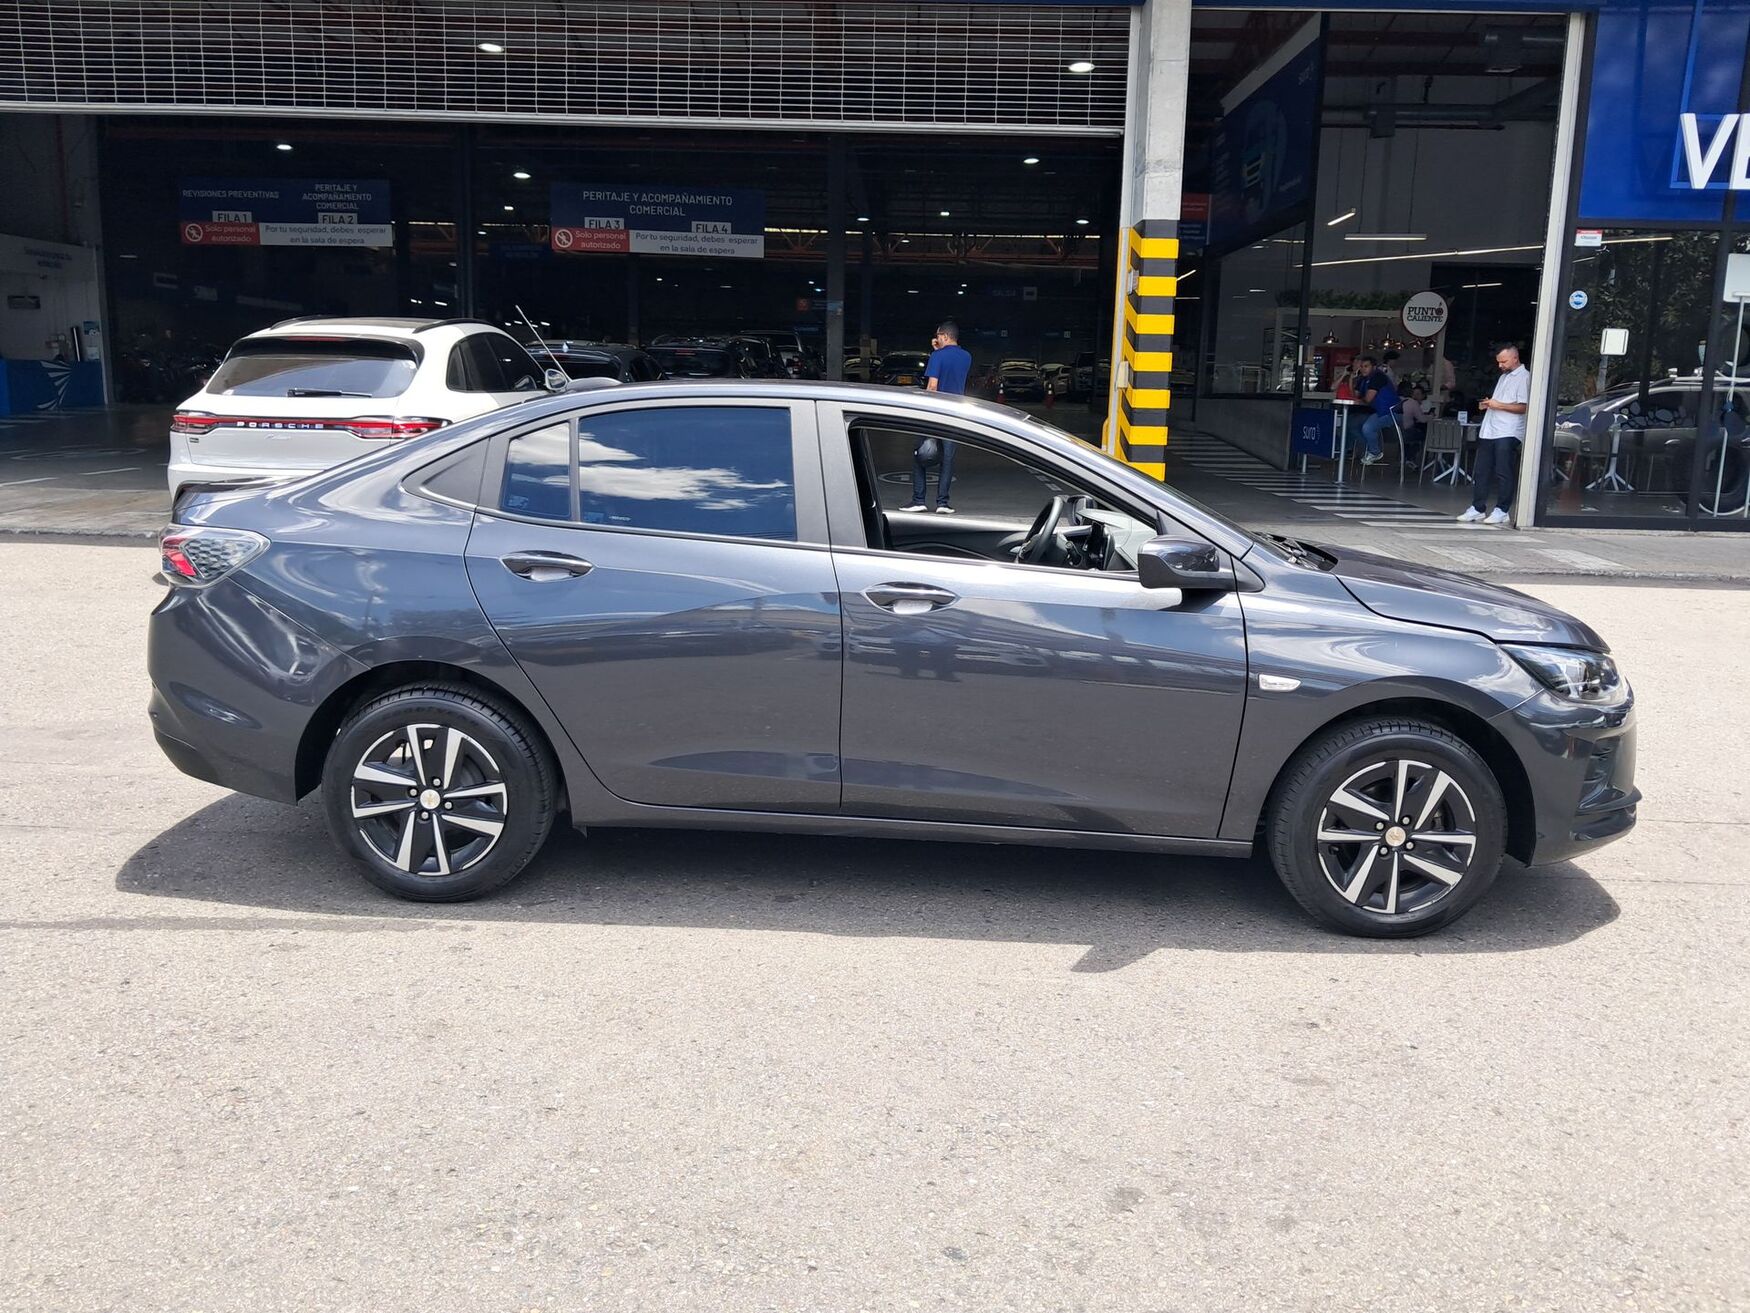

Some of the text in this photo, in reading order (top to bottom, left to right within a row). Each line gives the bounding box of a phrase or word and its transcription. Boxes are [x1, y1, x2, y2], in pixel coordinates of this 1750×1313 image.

[314, 184, 358, 192] PERITAJE Y
[182, 190, 280, 199] REVISIONES PREVENTIVAS
[302, 192, 372, 201] ACOMPAÑAMIENTO
[583, 191, 639, 202] PERITAJE Y
[641, 192, 733, 206] ACOMPAÑAMIENTO
[316, 202, 359, 210] COMERCIAL
[629, 205, 686, 216] COMERCIAL
[217, 213, 248, 222] FILA 1
[322, 215, 354, 224] FILA 2
[588, 219, 621, 229] FILA 3
[695, 223, 728, 234] FILA 4
[223, 225, 256, 234] personal
[593, 231, 626, 241] personal
[659, 233, 699, 243] seguridad,
[701, 235, 725, 243] debes
[728, 237, 758, 245] esperar
[581, 241, 621, 249] autorizado
[709, 247, 735, 255] espera
[1408, 306, 1443, 315] PUNTO
[236, 421, 324, 429] PORSCHE
